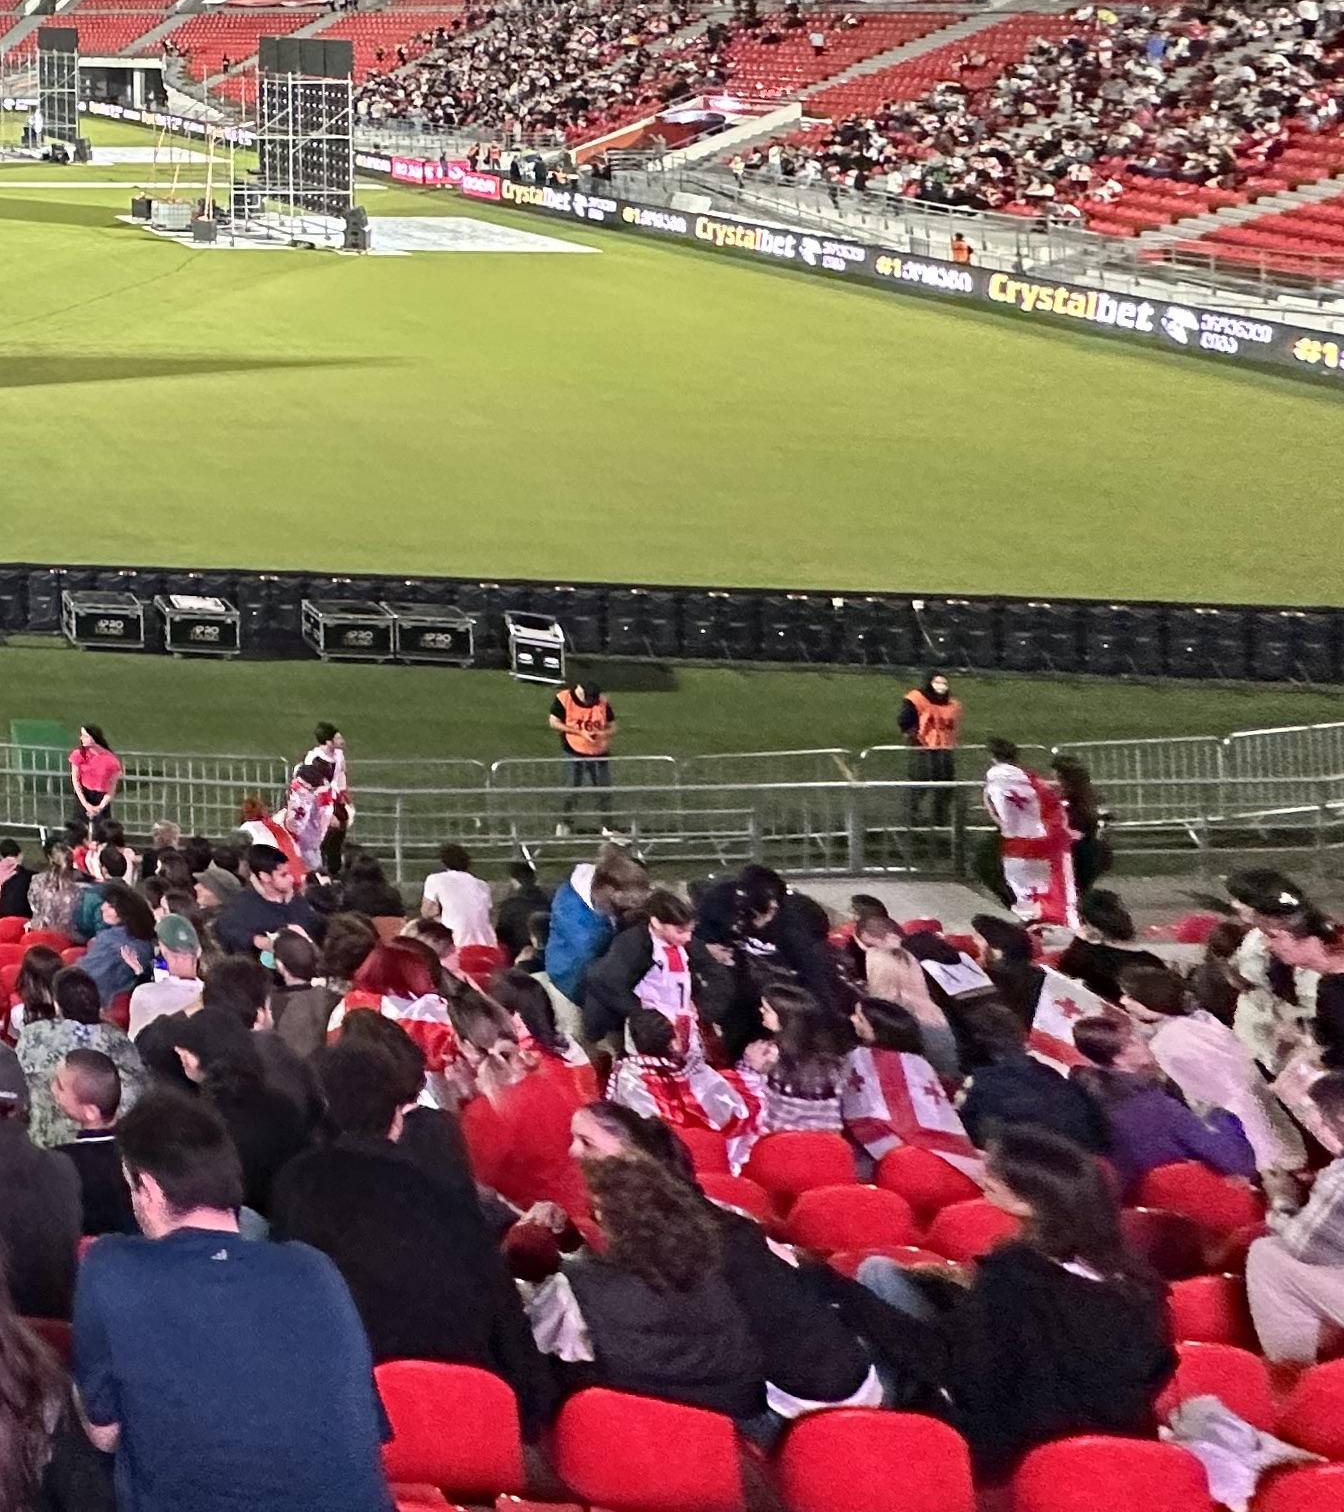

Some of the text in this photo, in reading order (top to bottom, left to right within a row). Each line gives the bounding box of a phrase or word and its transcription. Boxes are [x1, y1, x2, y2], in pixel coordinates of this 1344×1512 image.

[502, 179, 571, 211] Crystalbet
[695, 216, 796, 258] Crystalbet
[988, 273, 1154, 332] Crystalbet
